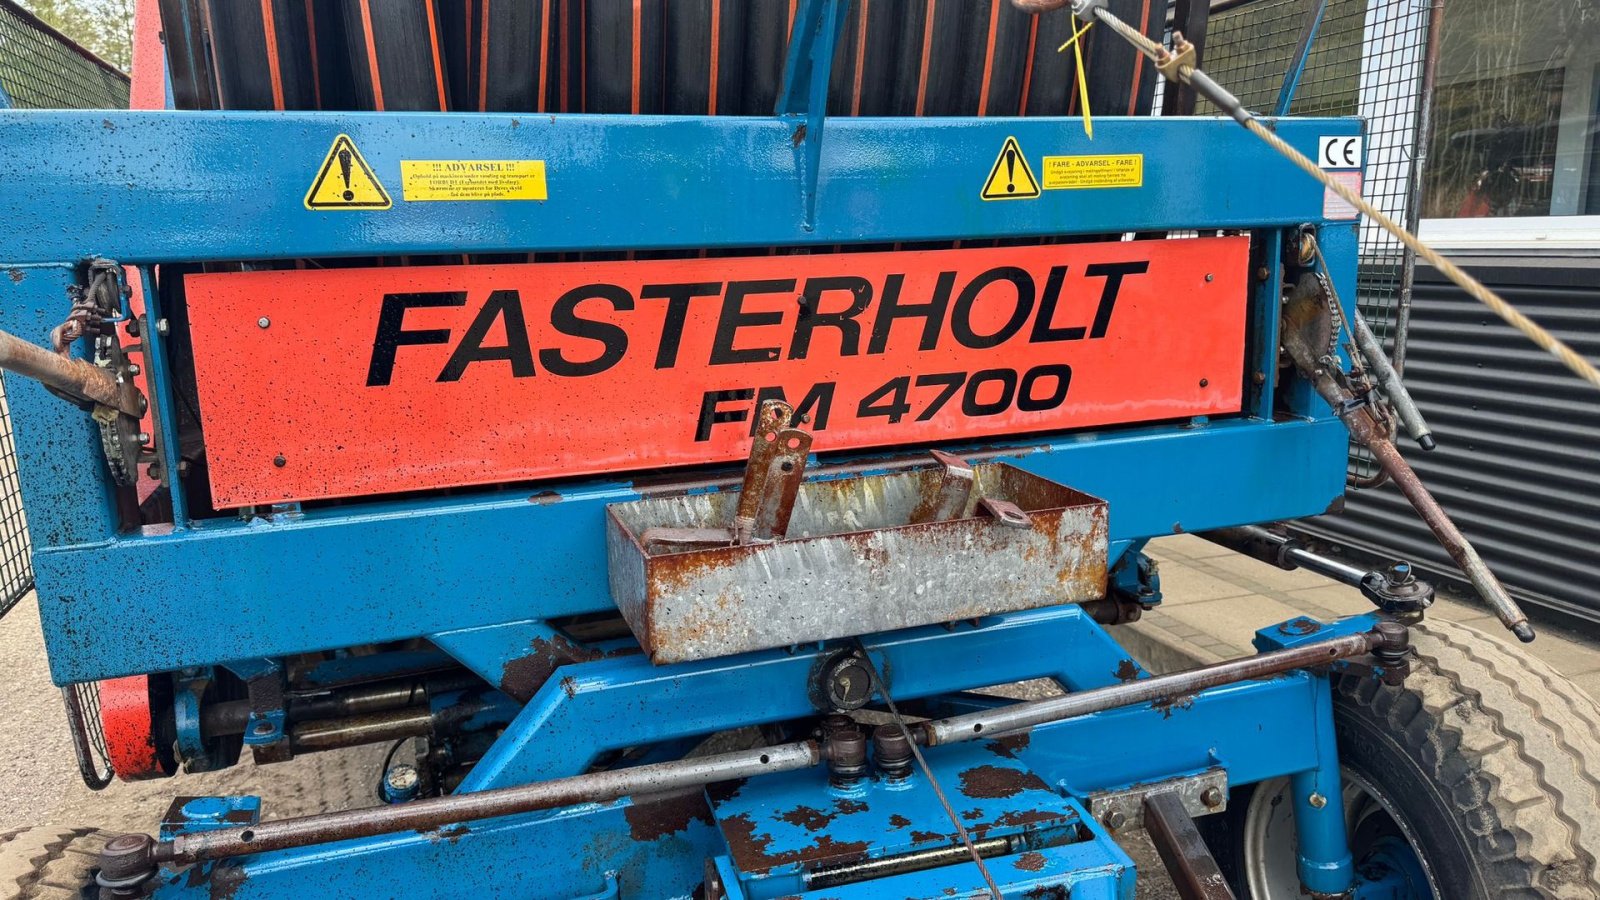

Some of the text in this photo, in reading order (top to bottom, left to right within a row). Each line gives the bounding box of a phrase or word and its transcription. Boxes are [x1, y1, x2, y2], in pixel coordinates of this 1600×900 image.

[1075, 159, 1111, 167] ADVARSEL
[1325, 138, 1356, 166] CE
[444, 163, 504, 172] ADVARSEL
[366, 260, 1149, 386] FASTERHOLT
[694, 363, 1073, 442] FM 4700
